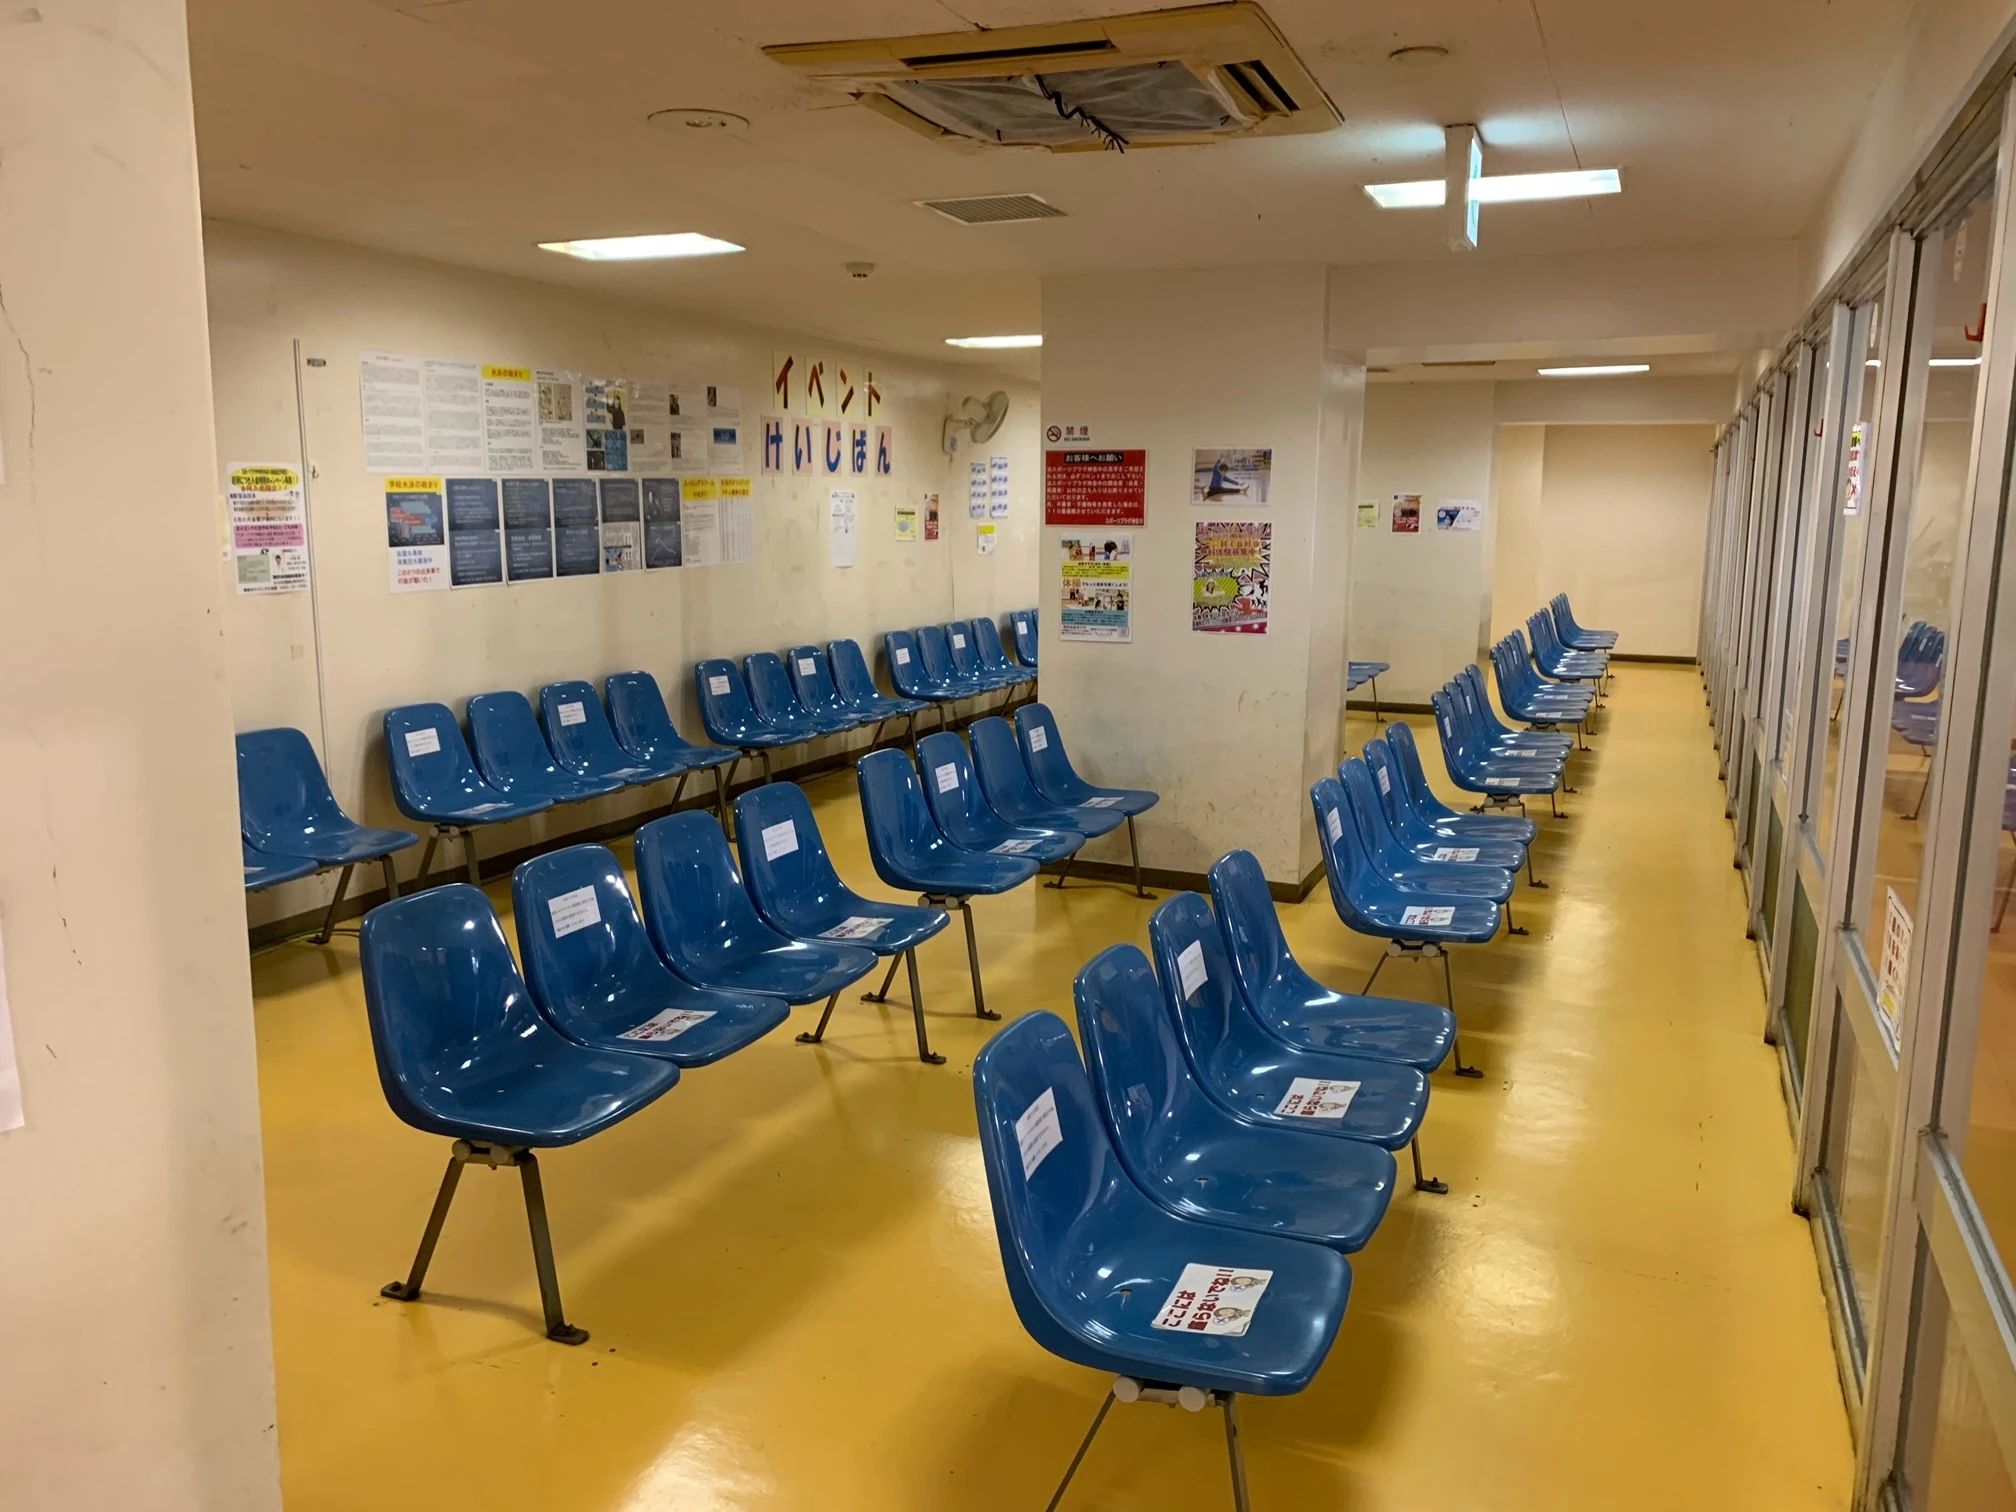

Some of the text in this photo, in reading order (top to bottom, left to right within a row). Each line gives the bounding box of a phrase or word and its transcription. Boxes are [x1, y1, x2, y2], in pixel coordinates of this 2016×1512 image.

[776, 355, 881, 417] イベント
[765, 421, 891, 474] けいじばん
[1065, 425, 1089, 436] 禁煙
[1065, 453, 1122, 463] お客様へお願い
[1161, 1289, 1197, 1328] ここには
